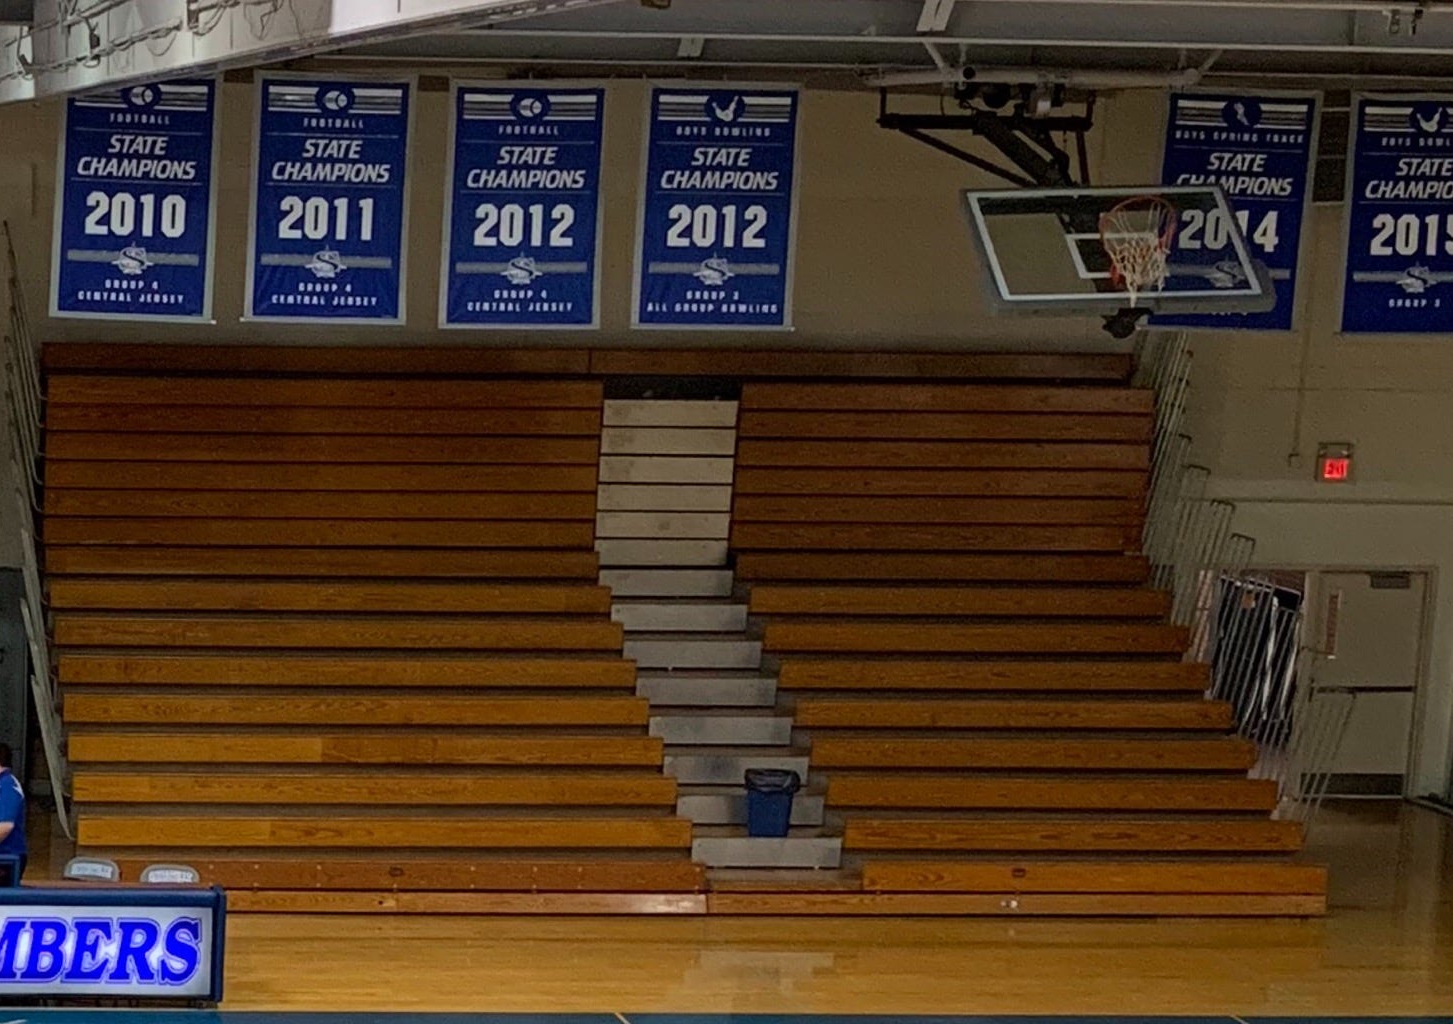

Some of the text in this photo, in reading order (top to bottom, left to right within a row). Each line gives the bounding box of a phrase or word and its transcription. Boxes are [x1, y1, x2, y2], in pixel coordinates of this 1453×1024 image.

[110, 113, 170, 125] FOOTBALL
[303, 118, 364, 128] FOOTBALL
[108, 135, 168, 154] STATE
[303, 139, 362, 159] STATE
[497, 147, 558, 164] STATE
[691, 148, 752, 166] STATE
[1208, 153, 1267, 172] STATE
[77, 157, 196, 179] CHAMPIONS
[272, 162, 391, 183] CHAMPIONS
[1396, 158, 1453, 176] STATE
[467, 169, 586, 188] CHAMPIONS
[661, 171, 779, 190] CHAMPIONS
[85, 191, 186, 238] 2010
[279, 196, 373, 240] 2011
[474, 203, 575, 246] 2012
[667, 204, 767, 248] 2012
[105, 280, 159, 289] GROUP 4
[299, 283, 338, 292] GROUP
[78, 290, 184, 303] CENTRAL JERSEY
[272, 295, 377, 306] CENTRAL JERSEY
[494, 290, 534, 299] GROUP
[686, 291, 726, 300] GROUP
[467, 302, 573, 312] CENTRAL JERSEY
[647, 303, 778, 313] ALL GROUP BOWLING
